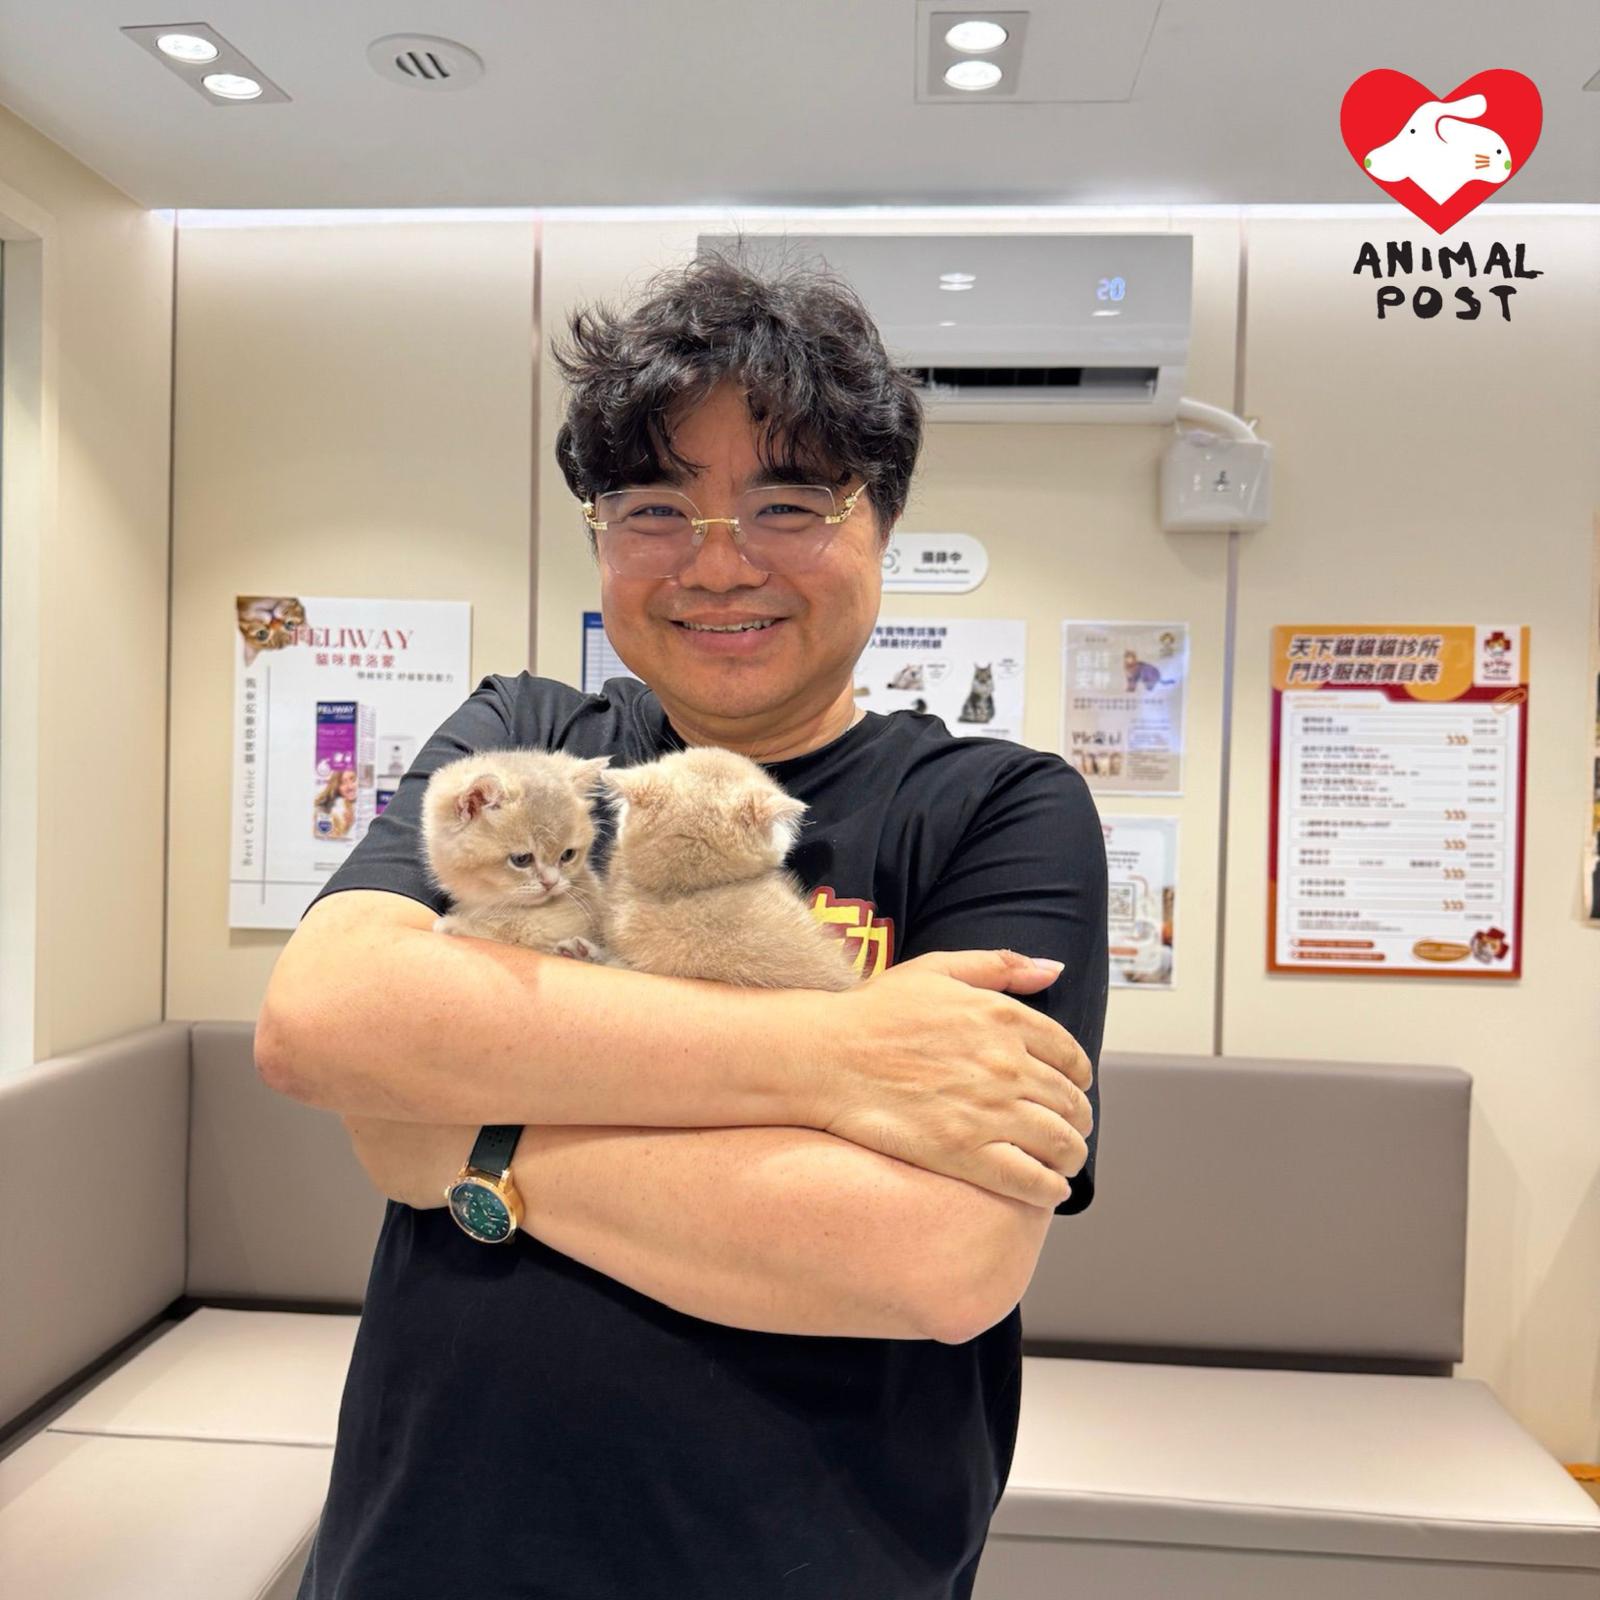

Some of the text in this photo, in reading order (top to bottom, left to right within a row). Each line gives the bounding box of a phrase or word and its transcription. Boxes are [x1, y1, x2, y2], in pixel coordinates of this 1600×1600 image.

[1096, 277, 1125, 301] 20
[290, 628, 413, 650] FELIWAY
[1289, 636, 1441, 657] 天下貓貓貓診所
[1288, 662, 1440, 682] 門診服務價目表
[244, 768, 256, 808] Clinic
[244, 812, 255, 834] Cat
